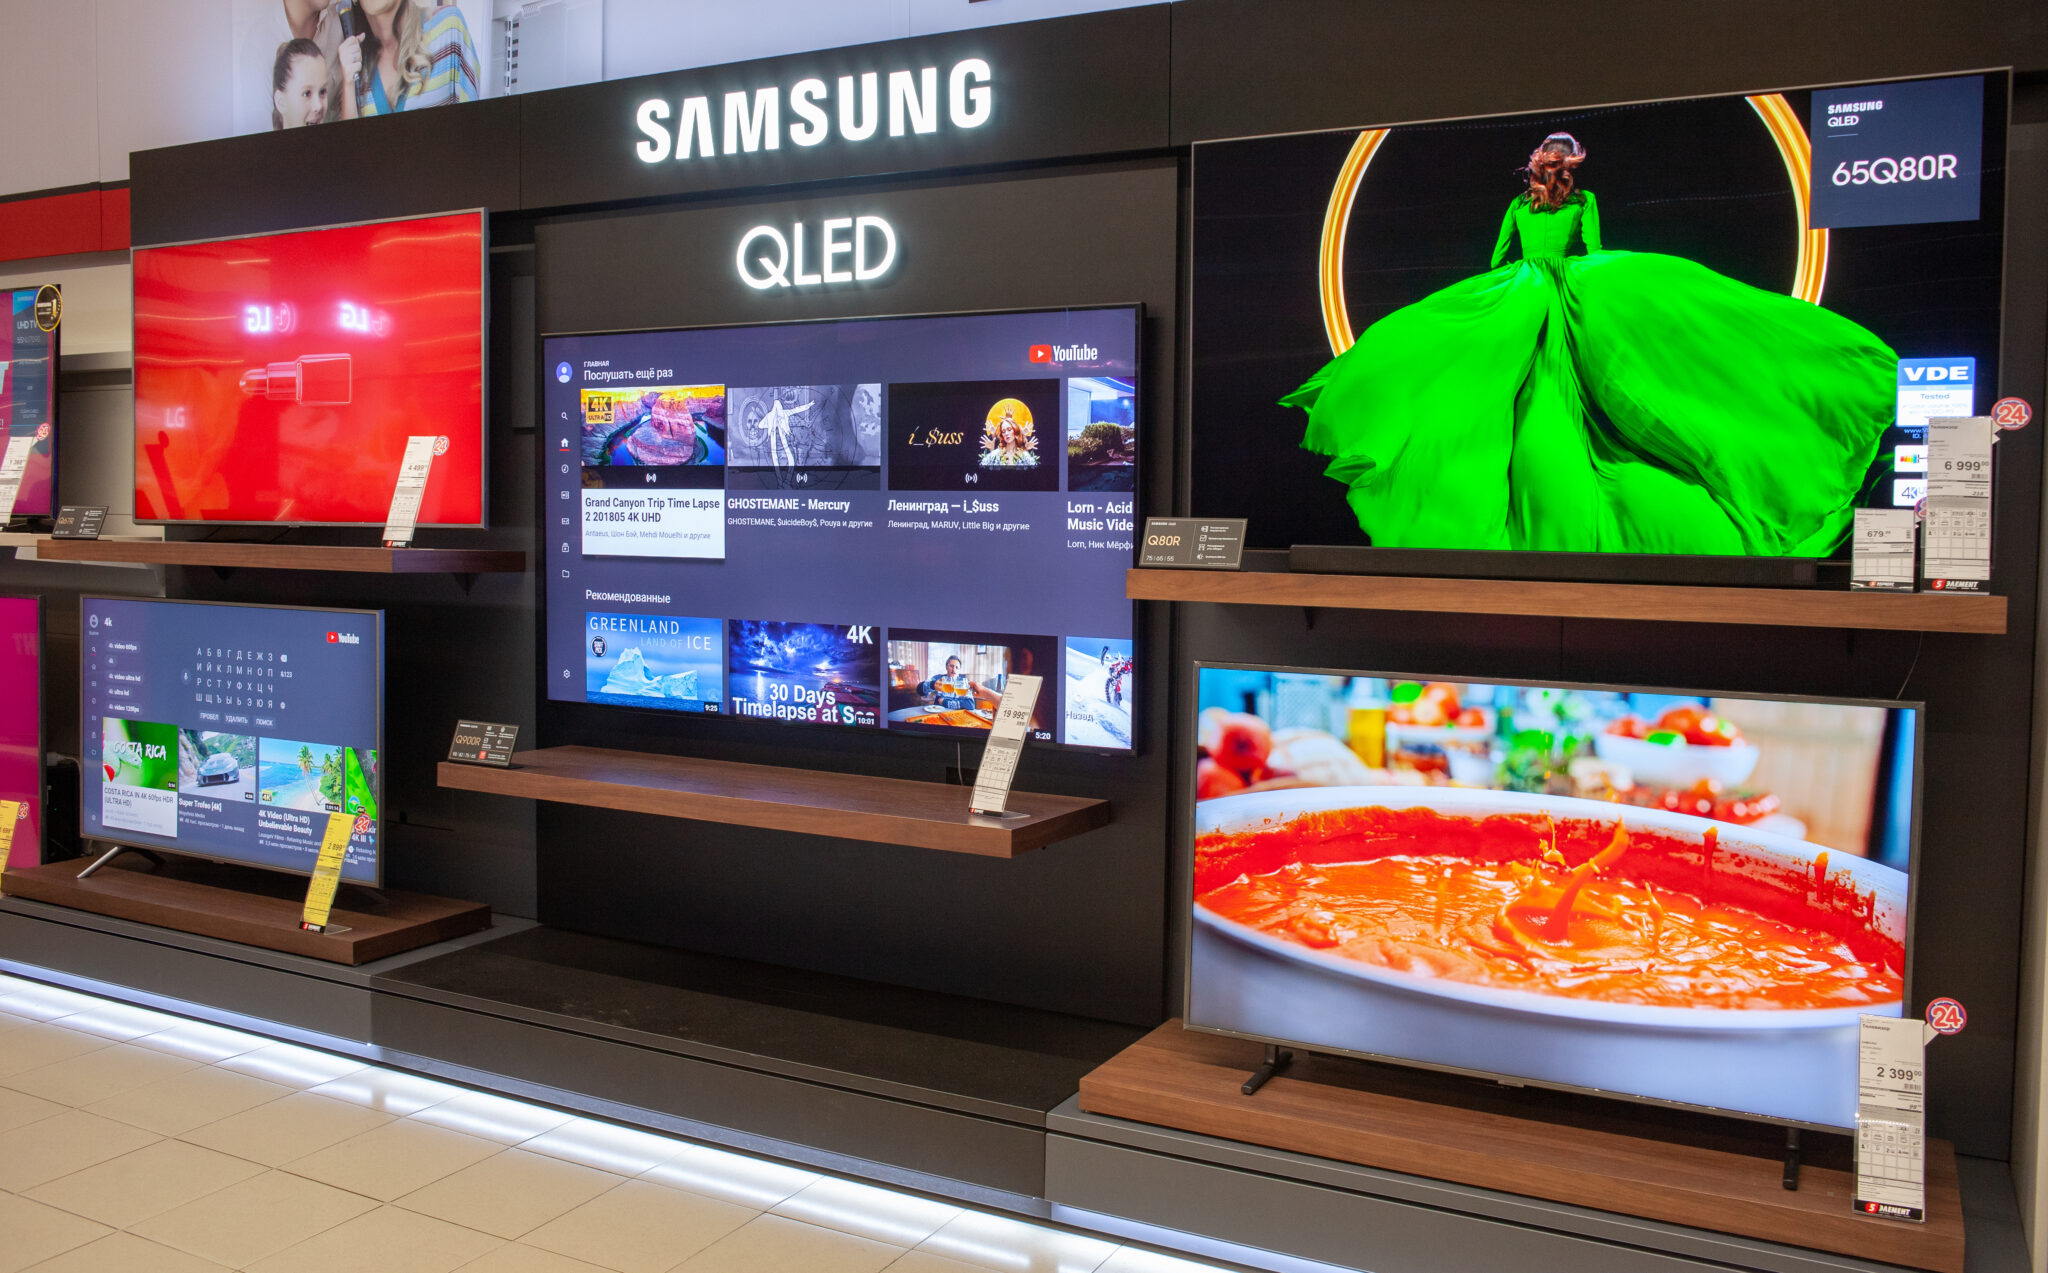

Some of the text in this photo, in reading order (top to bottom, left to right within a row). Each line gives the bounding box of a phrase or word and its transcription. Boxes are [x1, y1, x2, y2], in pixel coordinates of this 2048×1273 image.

[636, 58, 992, 164] SAMSUNG
[1828, 100, 1883, 114] SAMSUNG
[1828, 115, 1859, 128] QLED
[1832, 154, 1958, 186] 65Q80R
[736, 215, 897, 290] QLED
[1052, 344, 1098, 362] YouTube
[584, 360, 610, 368] ГЛАВНАЯ
[584, 368, 673, 382] Послушать ещё раз
[1904, 366, 1969, 381] VDE
[591, 397, 609, 412] 4K
[1996, 404, 2028, 425] 24
[434, 440, 447, 453] 24
[1944, 461, 1981, 471] 6 999
[585, 497, 720, 510] Grand Canyon Trip Time Lapse
[728, 498, 850, 513] GHOSTEMANE Mercury
[888, 499, 999, 514] Ленинград i_$uss
[1067, 501, 1133, 514] Lorn Acid
[585, 512, 662, 523] 2 201805 4K UHD
[728, 518, 776, 527] GHOSTEMANE,
[820, 519, 840, 529] Pouya
[848, 520, 873, 529] другие
[1067, 518, 1134, 531] Music Vide
[888, 520, 929, 530] Ленинград,
[931, 521, 961, 530] MARUV,
[962, 521, 981, 530] Little
[982, 522, 995, 531] Big
[1003, 522, 1030, 531] другие
[689, 532, 711, 541] другие
[1148, 535, 1180, 546] Q80R
[1067, 540, 1105, 549] Lorn, Ник
[585, 589, 671, 604] Рекомендованные
[104, 617, 112, 627] 4k
[590, 616, 680, 635] GREENLAND
[338, 632, 360, 644] YouTube
[847, 625, 873, 644] 4K
[641, 635, 712, 651] LAND OF ICE
[769, 684, 836, 708] 30 Days
[732, 697, 817, 721] Timelapse
[822, 705, 838, 722] at
[1004, 709, 1012, 718] 19
[226, 715, 248, 724] УДАЛИТЬ
[857, 716, 875, 725] 10:01
[1065, 711, 1094, 723] Назад
[456, 735, 481, 746] Q900R
[1035, 731, 1051, 740] 5:20
[113, 741, 166, 760] COSTA RICA
[105, 787, 121, 795] COSTA
[122, 789, 134, 798] RICA
[141, 791, 147, 799] 4K
[163, 795, 173, 803] HDR
[179, 798, 193, 807] Super
[194, 800, 211, 809] Trofeo
[259, 809, 311, 825] 4K Video (Ultra HD)
[259, 819, 312, 836] Unbelievable Beauty
[354, 817, 370, 833] 24
[1931, 1005, 1964, 1029] 24
[1877, 1066, 1914, 1081] 2 399
[1879, 1205, 1911, 1215] ЭЛЕМЕНТ
